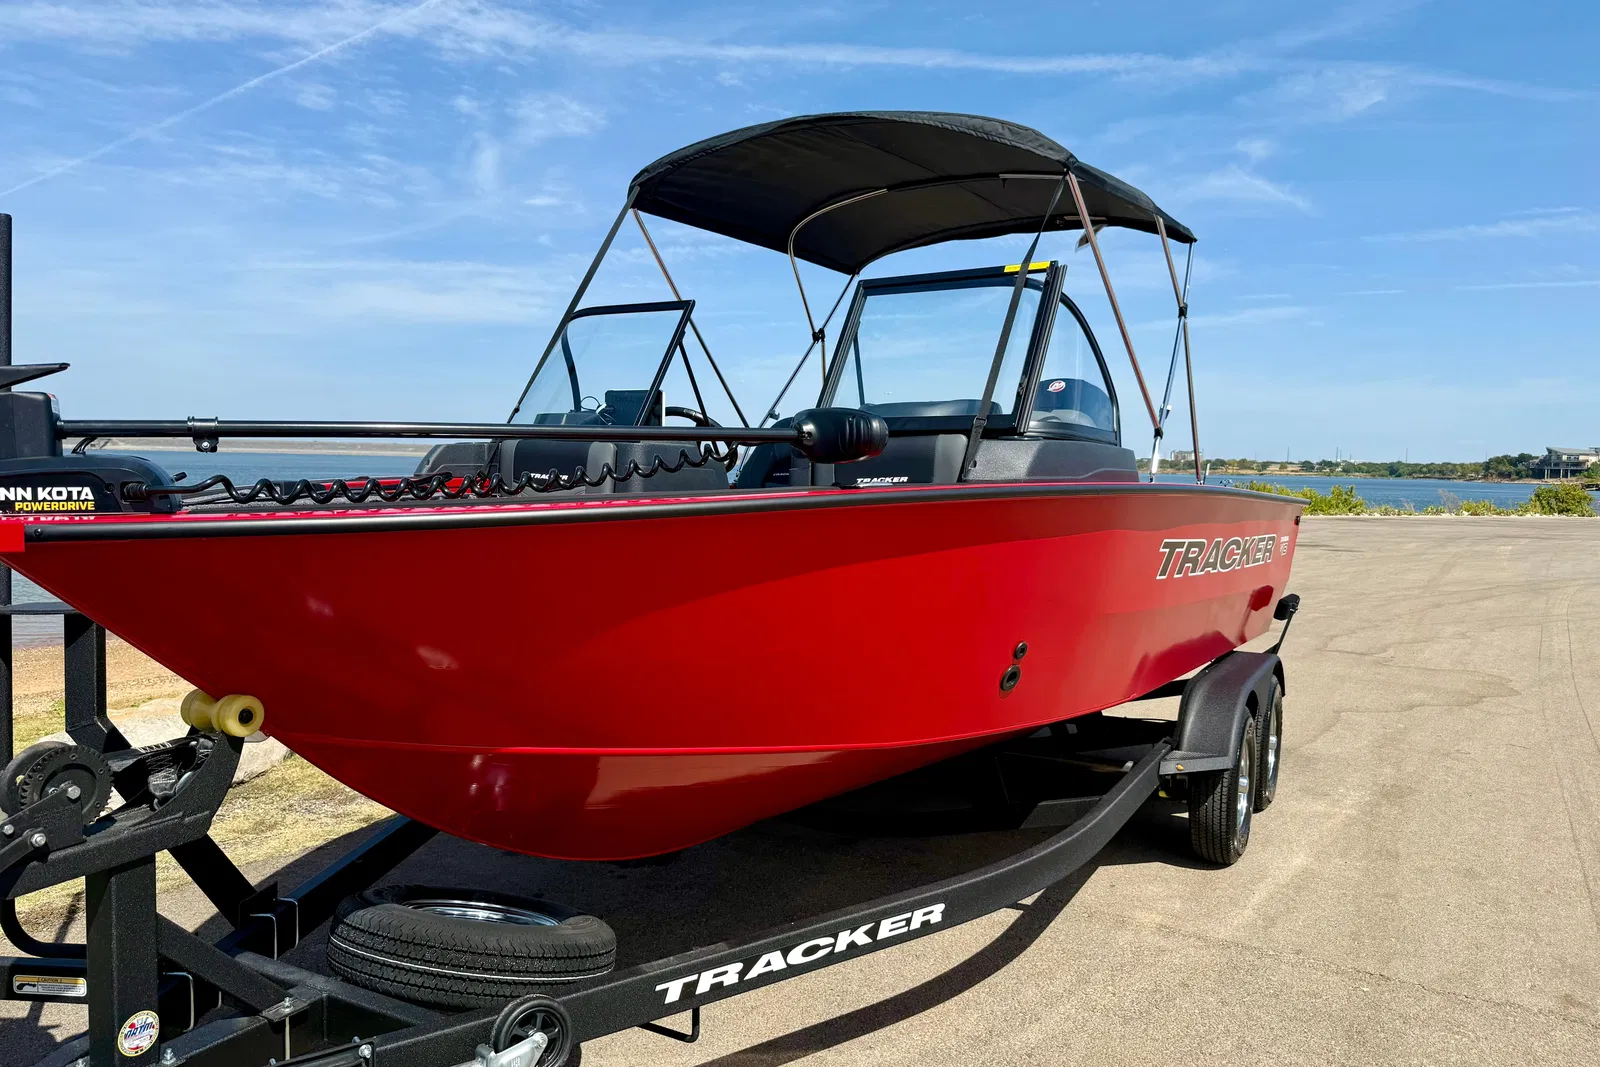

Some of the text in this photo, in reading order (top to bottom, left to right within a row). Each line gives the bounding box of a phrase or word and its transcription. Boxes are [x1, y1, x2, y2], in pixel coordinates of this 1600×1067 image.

[530, 472, 569, 480] TRACR
[856, 476, 909, 484] TRACKER
[37, 487, 95, 501] KOTA
[15, 501, 95, 511] POWERDRIVE
[1156, 534, 1277, 580] TRACKER
[655, 903, 946, 1005] TRACKER
